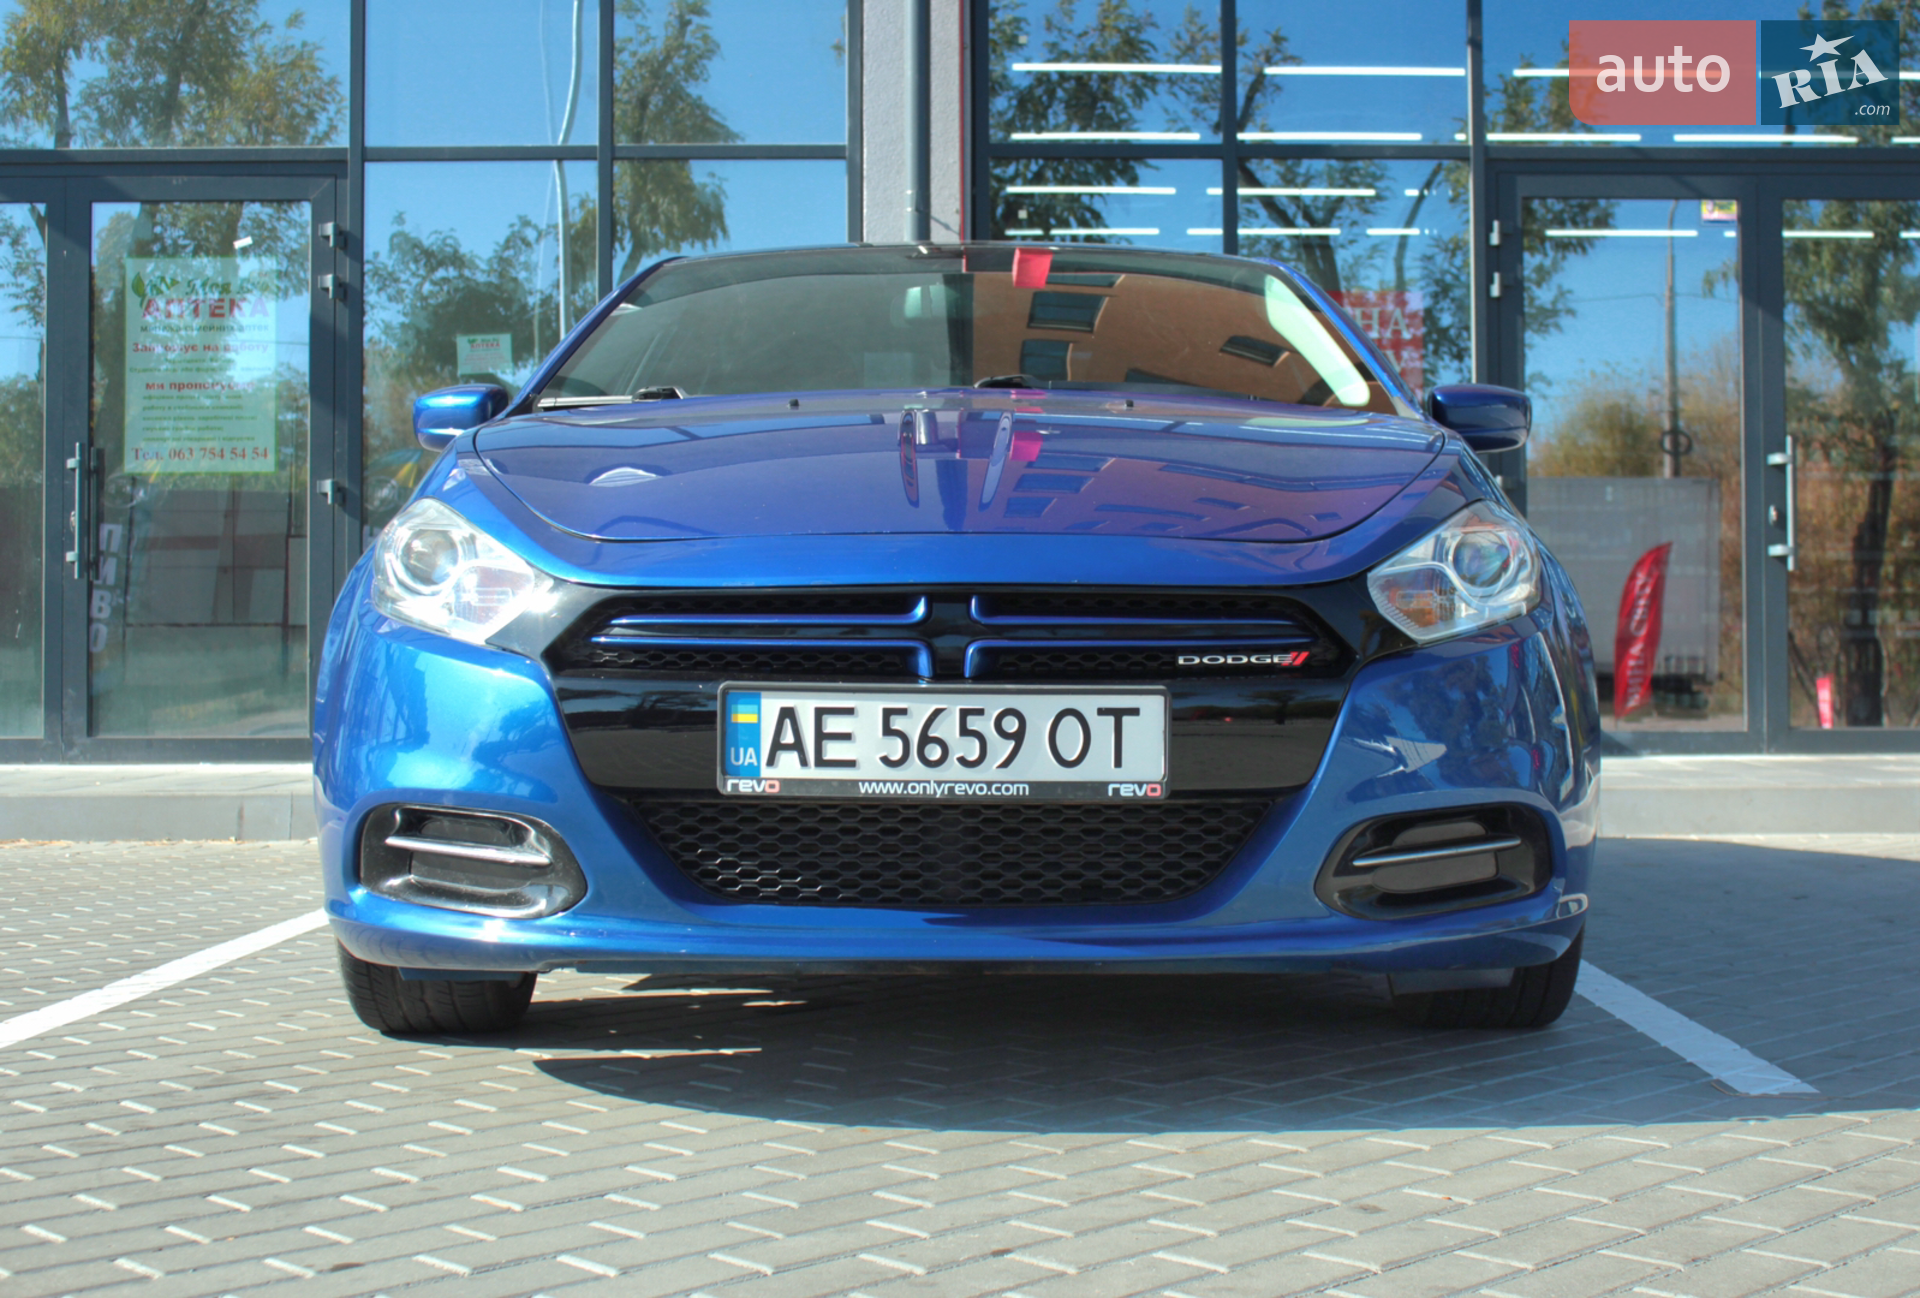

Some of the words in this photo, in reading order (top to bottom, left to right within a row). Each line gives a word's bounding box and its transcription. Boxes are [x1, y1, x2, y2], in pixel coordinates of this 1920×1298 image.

[142, 298, 270, 318] АПТЕКА
[224, 343, 269, 354] роботу
[145, 382, 165, 390] ми
[131, 447, 164, 460] Тел.
[168, 447, 195, 460] 063
[200, 447, 226, 460] 754
[230, 447, 247, 460] 54
[251, 447, 269, 460] 54
[90, 523, 122, 653] ПИВО
[1178, 654, 1293, 665] DODGE
[766, 706, 857, 768] AE
[878, 707, 1027, 769] 5659
[1048, 707, 1140, 769] OT
[730, 747, 758, 766] UA
[726, 779, 780, 793] revo
[858, 780, 1030, 797] www.onlyrevo.com
[1107, 783, 1161, 797] revo
